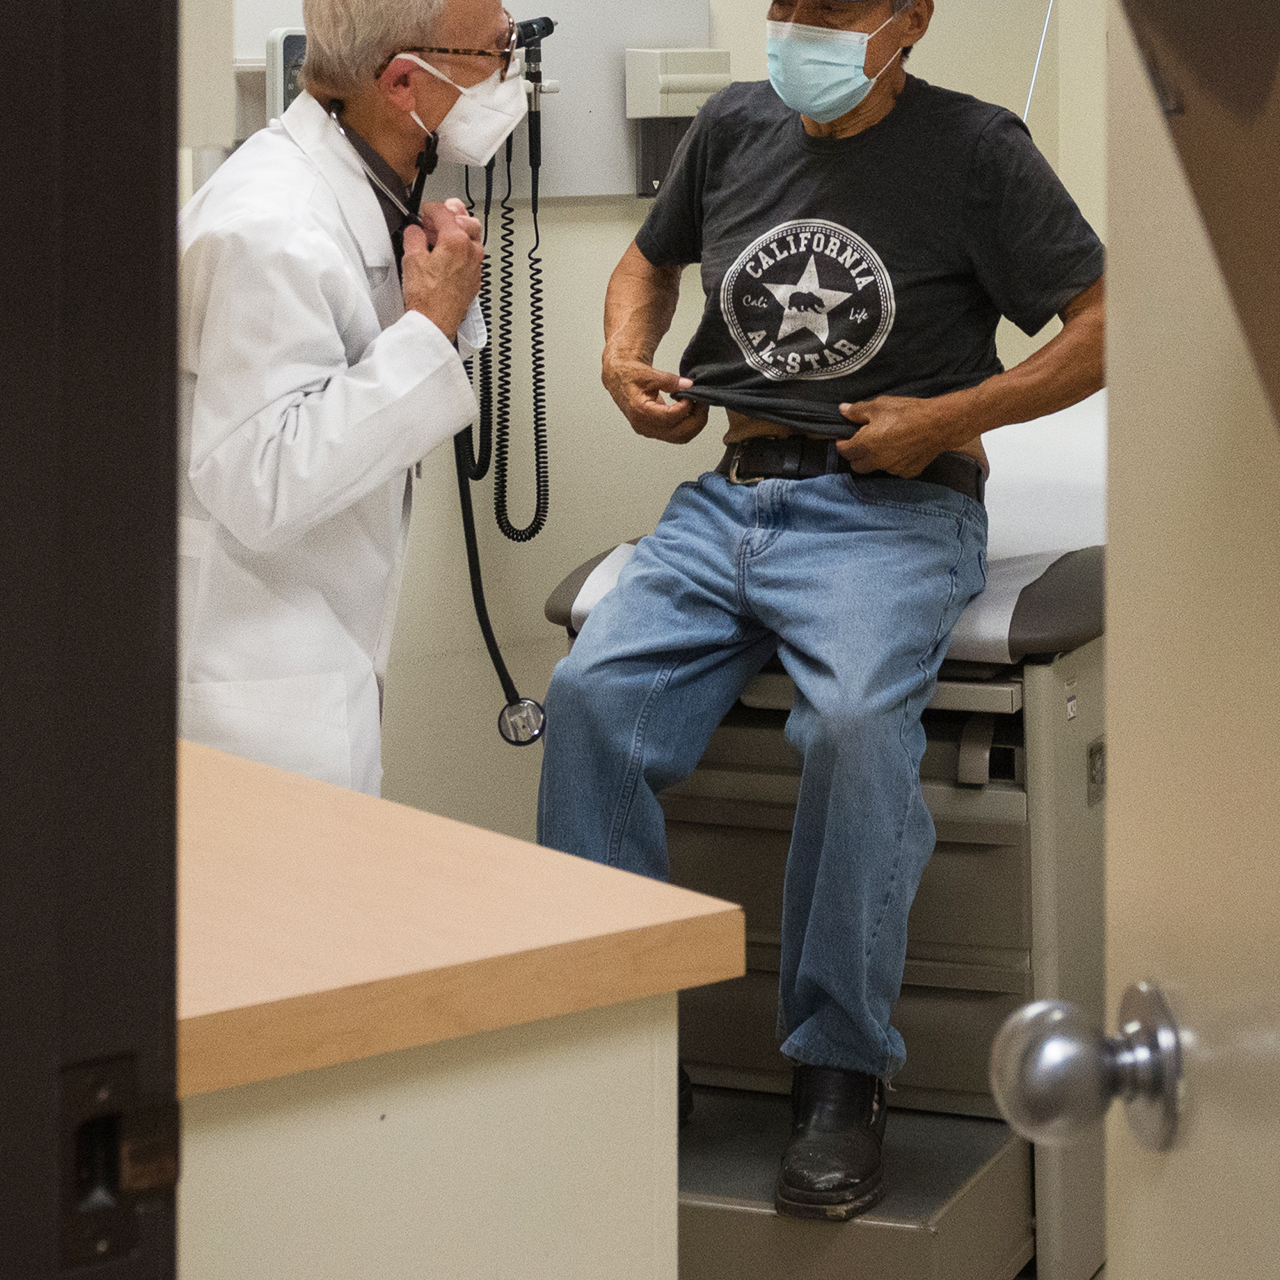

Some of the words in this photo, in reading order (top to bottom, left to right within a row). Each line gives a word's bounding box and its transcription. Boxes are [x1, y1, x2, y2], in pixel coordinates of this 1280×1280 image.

[745, 232, 876, 291] CALIFORNIA
[742, 295, 768, 309] Cali
[849, 307, 869, 324] Life
